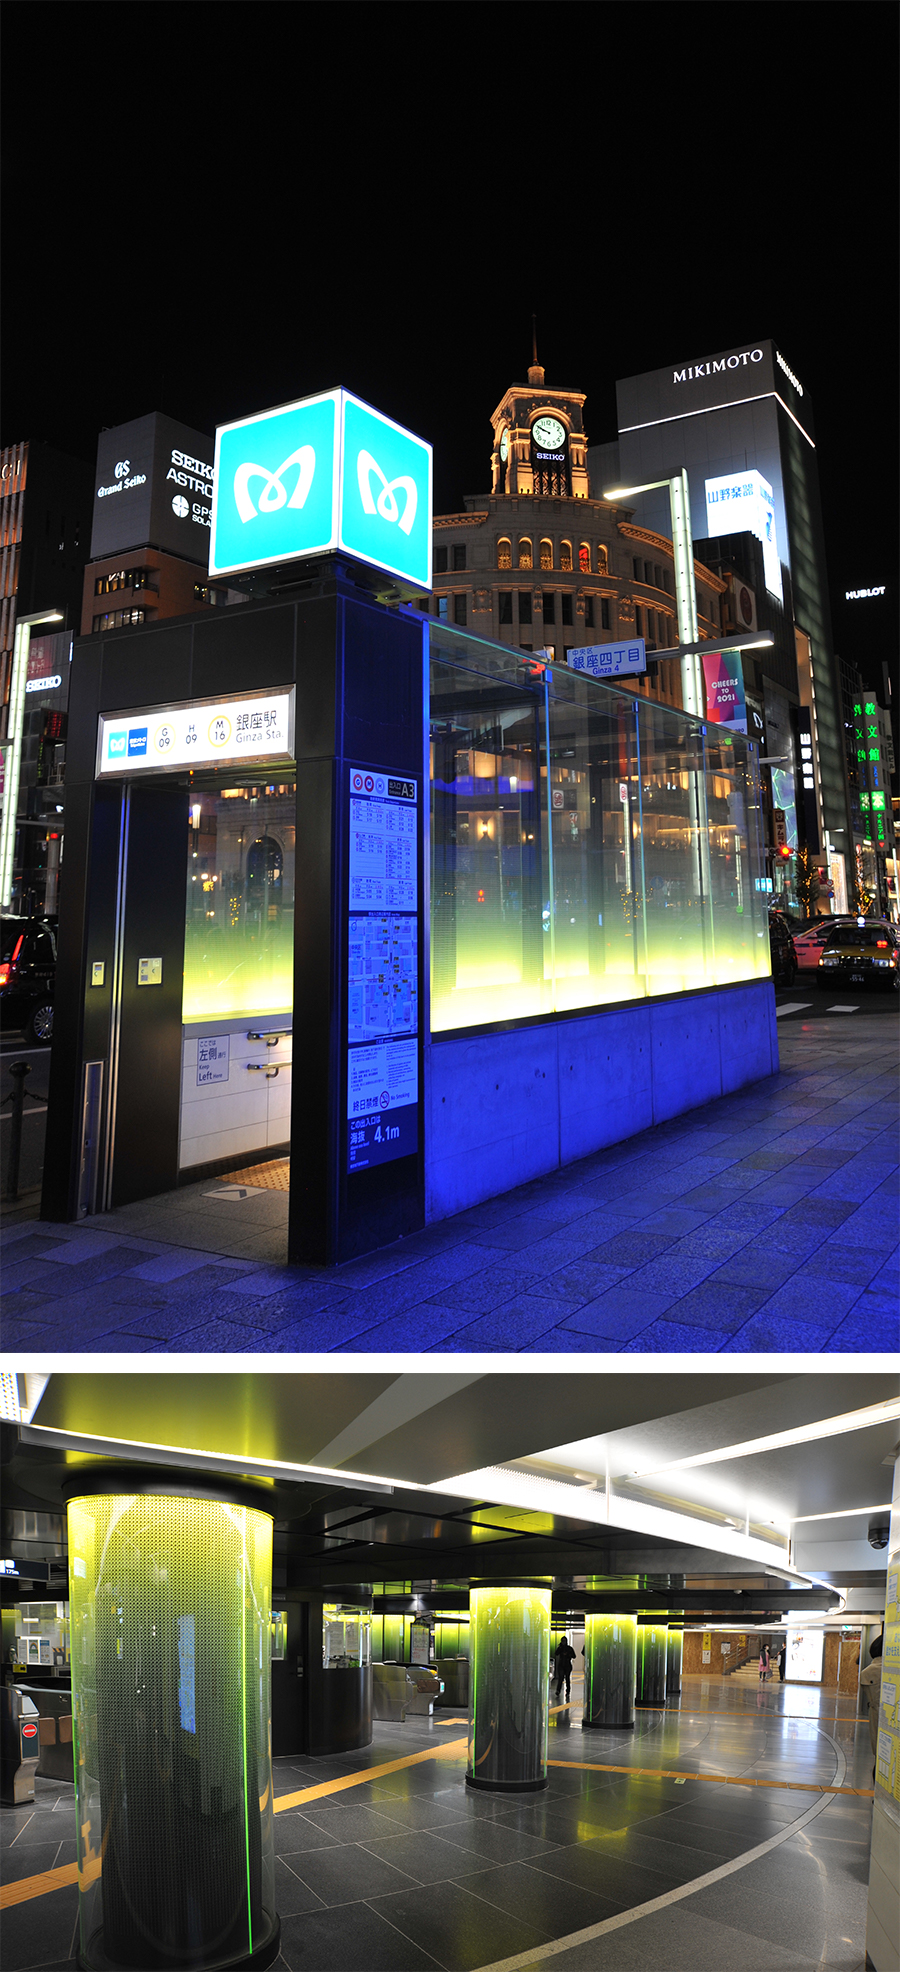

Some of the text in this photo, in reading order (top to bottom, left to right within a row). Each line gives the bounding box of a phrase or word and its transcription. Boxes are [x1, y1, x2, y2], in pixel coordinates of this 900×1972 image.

[673, 349, 764, 383] MIKIMOTO
[536, 453, 564, 461] SEIKO
[115, 460, 130, 479] GS
[98, 474, 147, 498] Grand Seiko
[845, 586, 886, 600] HUBLOT
[572, 647, 593, 656] 中央区
[573, 648, 640, 670] 銀座四丁目
[592, 664, 619, 675] Ginza 4
[711, 678, 738, 689] CHEERS
[716, 693, 735, 703] 2021
[216, 721, 224, 729] M
[236, 710, 277, 731] 銀座駅
[161, 728, 168, 737] G
[188, 724, 195, 732] H
[159, 737, 171, 748] 09
[185, 733, 197, 745] 09
[214, 731, 225, 741] 16
[235, 729, 284, 743] Ginza Sta.
[401, 783, 414, 798] A3
[199, 1047, 218, 1061] 左側
[199, 1071, 213, 1081] Left
[352, 1096, 379, 1112] 終日禁煙
[350, 1115, 381, 1130] この出入口は
[374, 1125, 400, 1143] 4.1m
